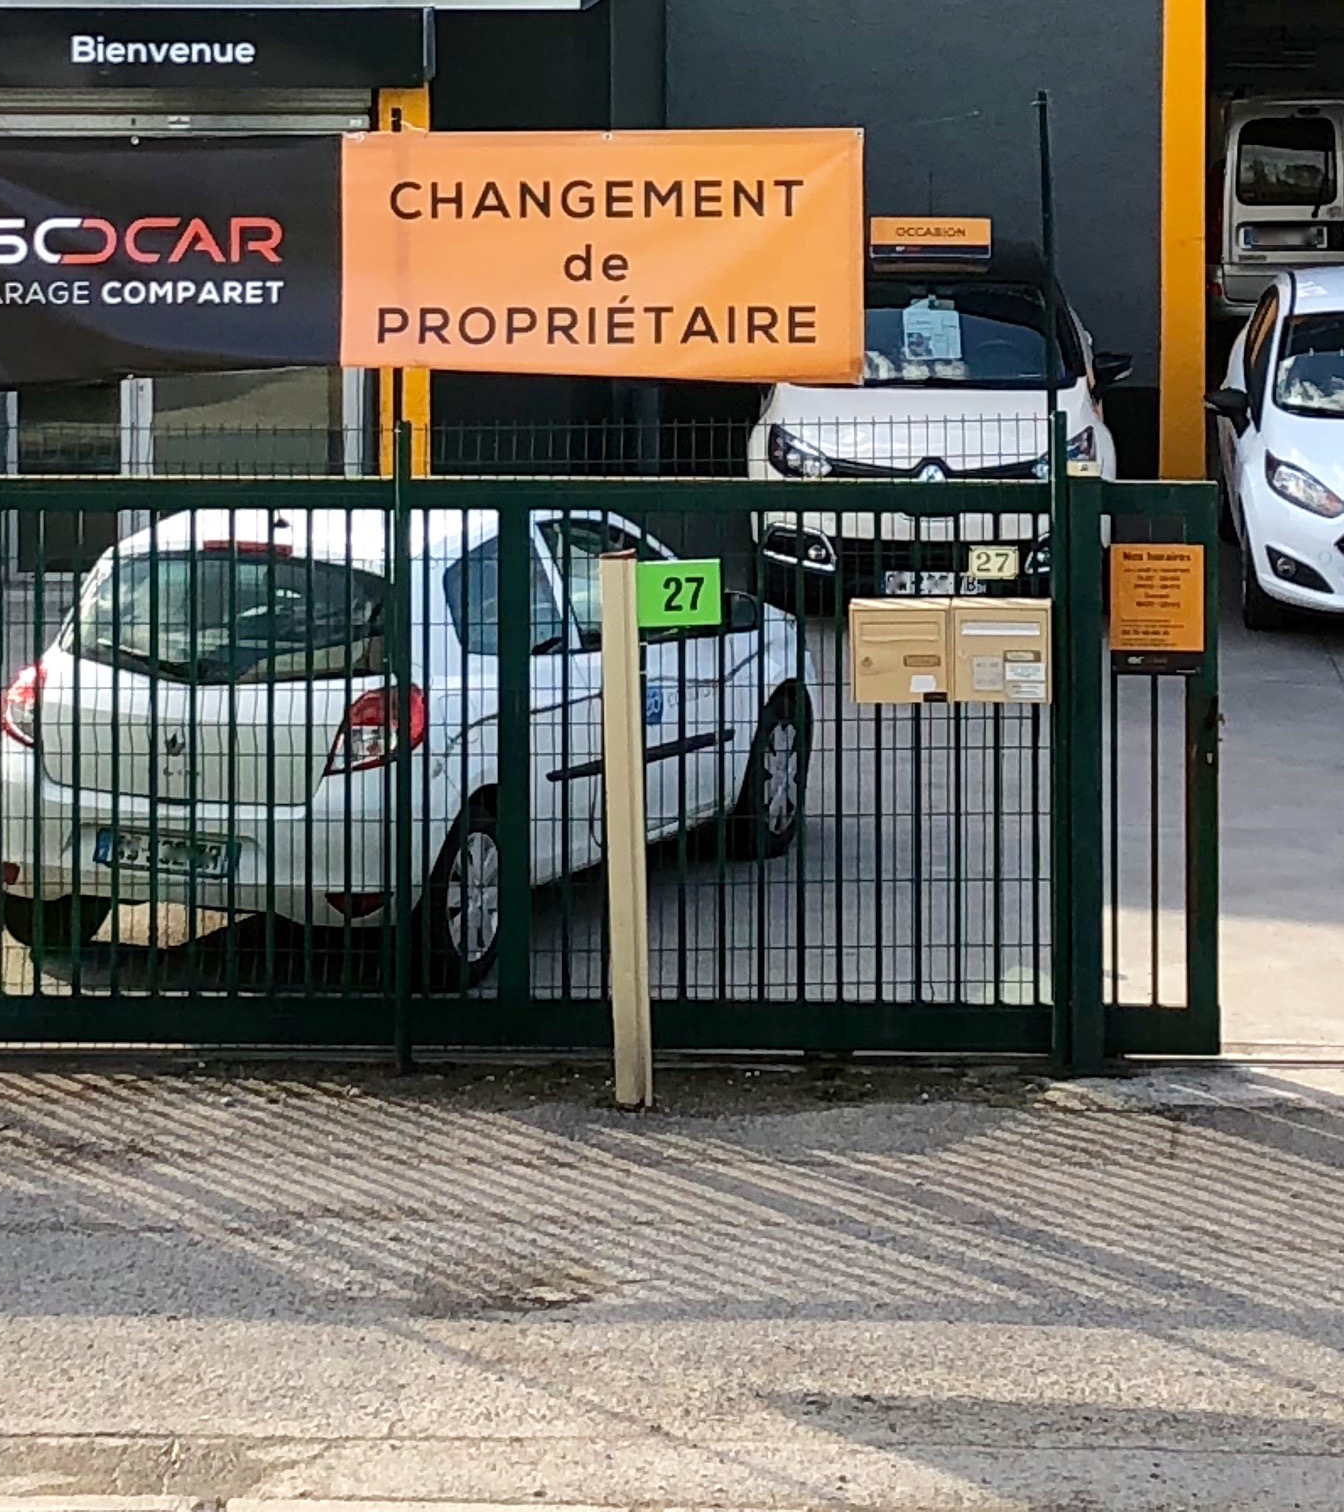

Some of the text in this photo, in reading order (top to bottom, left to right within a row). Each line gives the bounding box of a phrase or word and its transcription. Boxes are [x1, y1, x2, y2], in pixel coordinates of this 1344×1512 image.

[71, 35, 256, 64] Bienvenue
[389, 179, 804, 221] CHANGEMENT
[895, 227, 966, 237] OCCASION
[563, 243, 630, 282] de
[101, 280, 284, 305] COMPARET
[377, 296, 817, 345] PROPRIÉTAIRE
[975, 551, 1010, 573] 27
[663, 576, 705, 612] 27
